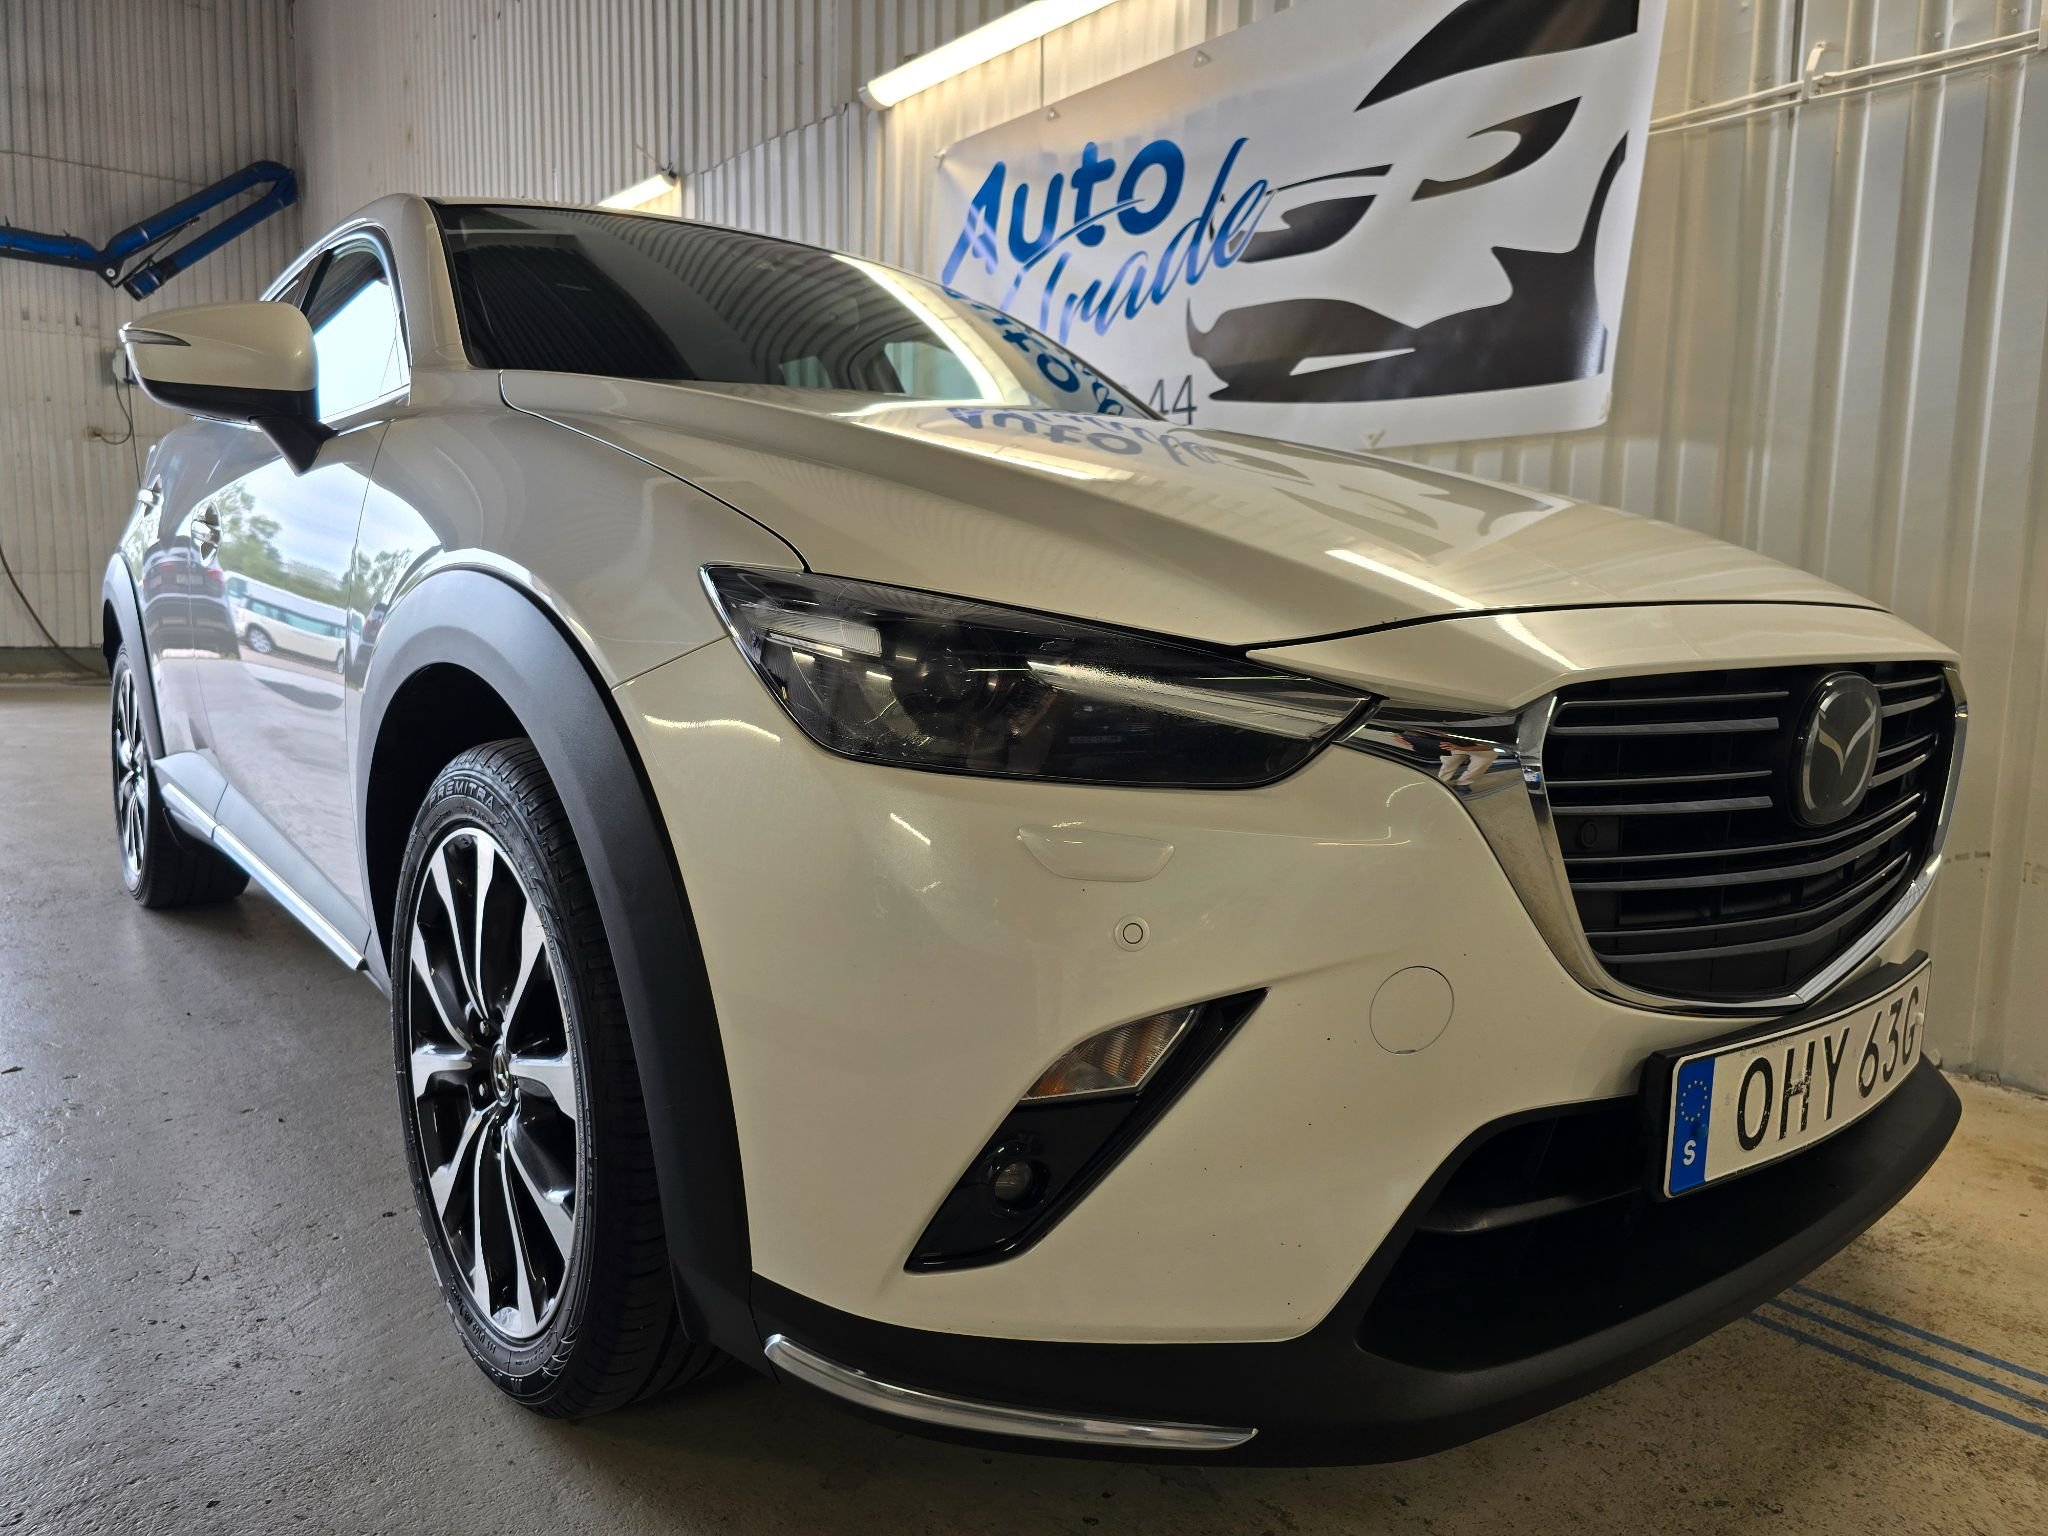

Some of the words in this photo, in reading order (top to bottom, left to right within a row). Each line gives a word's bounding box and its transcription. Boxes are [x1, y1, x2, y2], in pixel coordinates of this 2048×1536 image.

[429, 779, 495, 811] PREMITRA
[1737, 1027, 1849, 1151] OHY
[1856, 985, 1919, 1099] 63G
[1682, 1139, 1696, 1166] S
